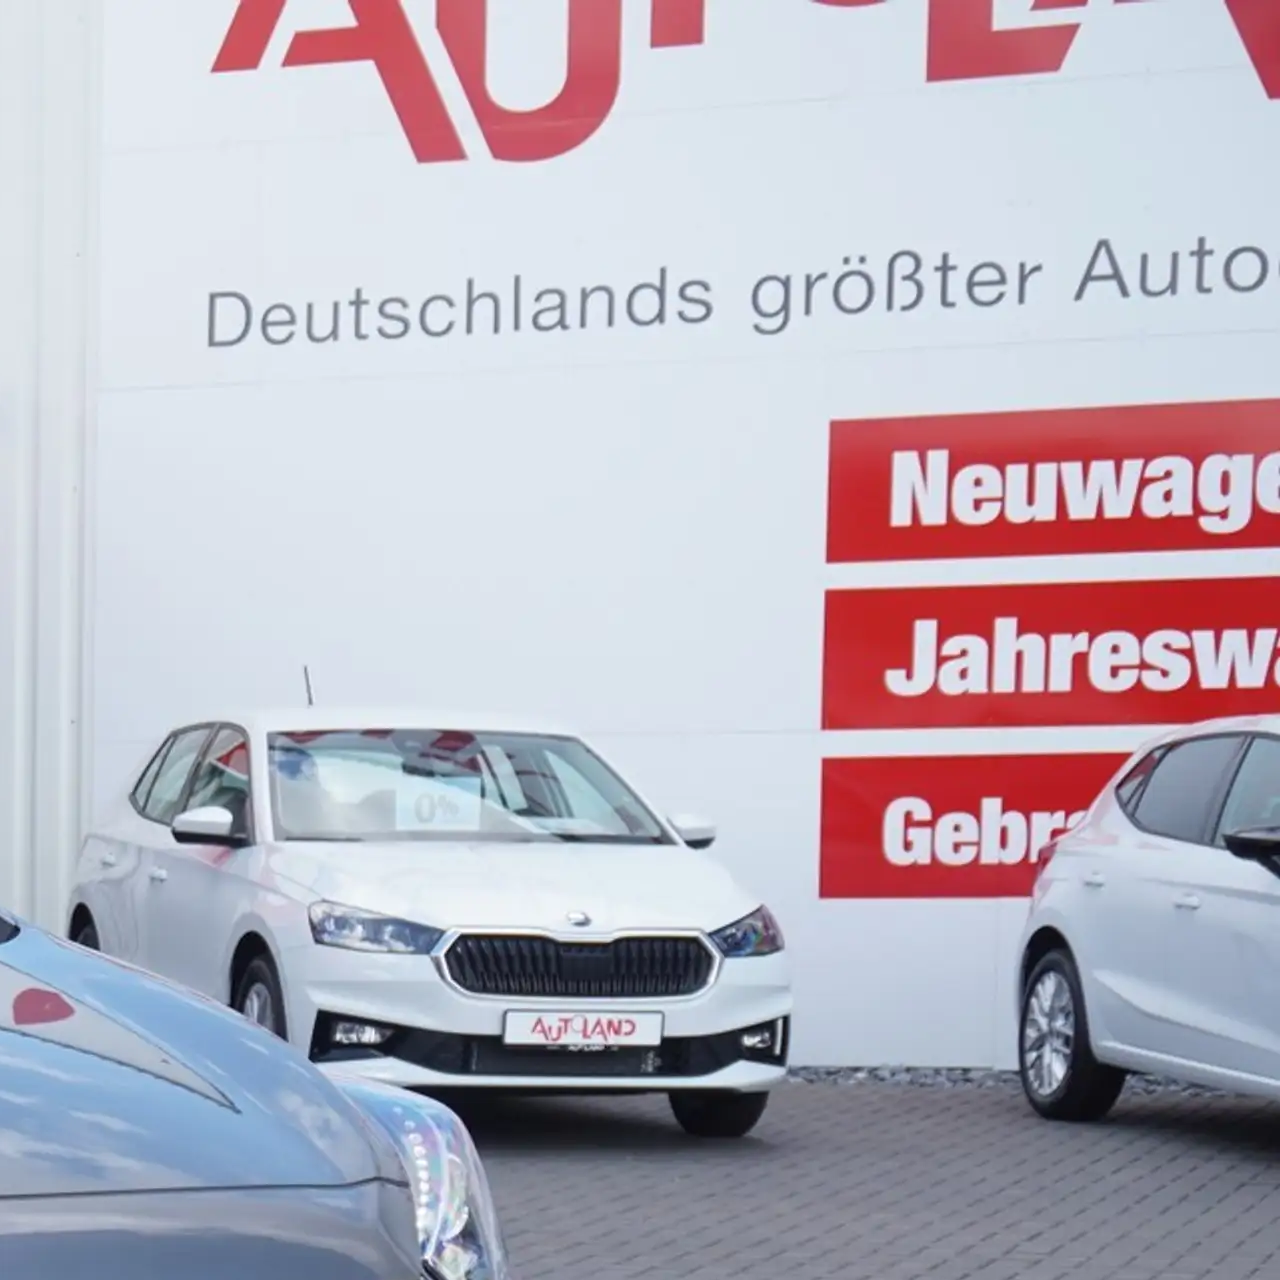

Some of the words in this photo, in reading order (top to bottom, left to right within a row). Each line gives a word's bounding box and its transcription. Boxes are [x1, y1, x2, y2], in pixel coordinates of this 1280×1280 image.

[207, 266, 714, 347] Deutschlands
[751, 250, 1042, 335] größter
[1074, 236, 1280, 301] Auto
[884, 617, 1280, 697] Jahresw
[882, 797, 1090, 866] Gebr
[532, 1014, 636, 1042] AUTOLAND
